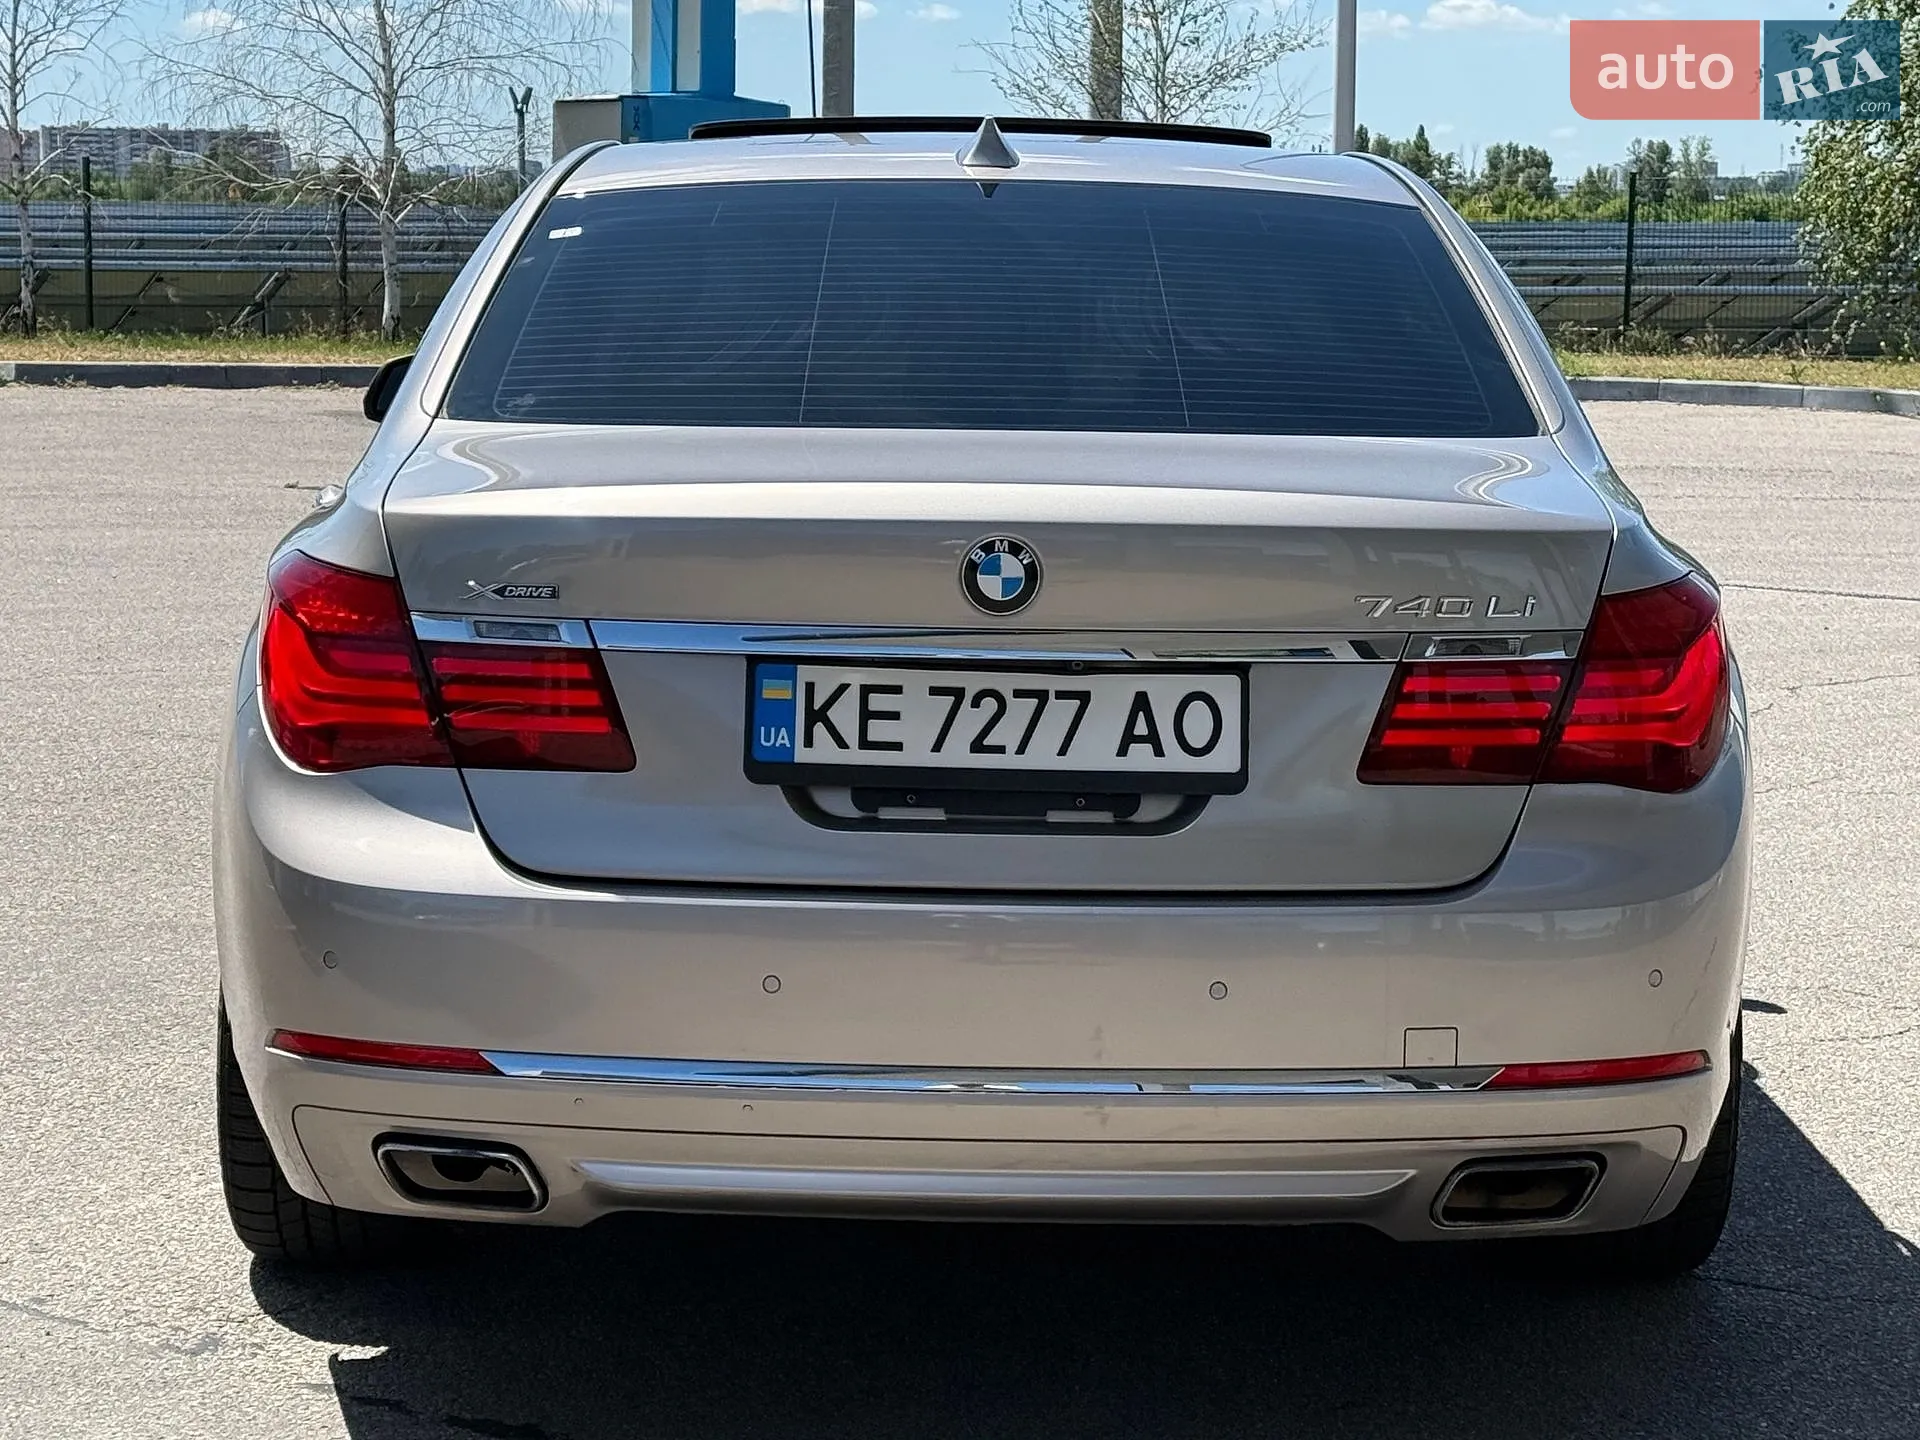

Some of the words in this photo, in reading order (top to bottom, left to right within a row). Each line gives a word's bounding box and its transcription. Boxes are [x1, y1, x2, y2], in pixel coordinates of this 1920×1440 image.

[970, 539, 1034, 565] BMW
[1354, 595, 1474, 618] 740
[1485, 595, 1537, 618] Li
[803, 681, 904, 752] KE
[928, 685, 1092, 757] 7277
[1115, 690, 1223, 759] AO
[760, 726, 791, 747] UA
